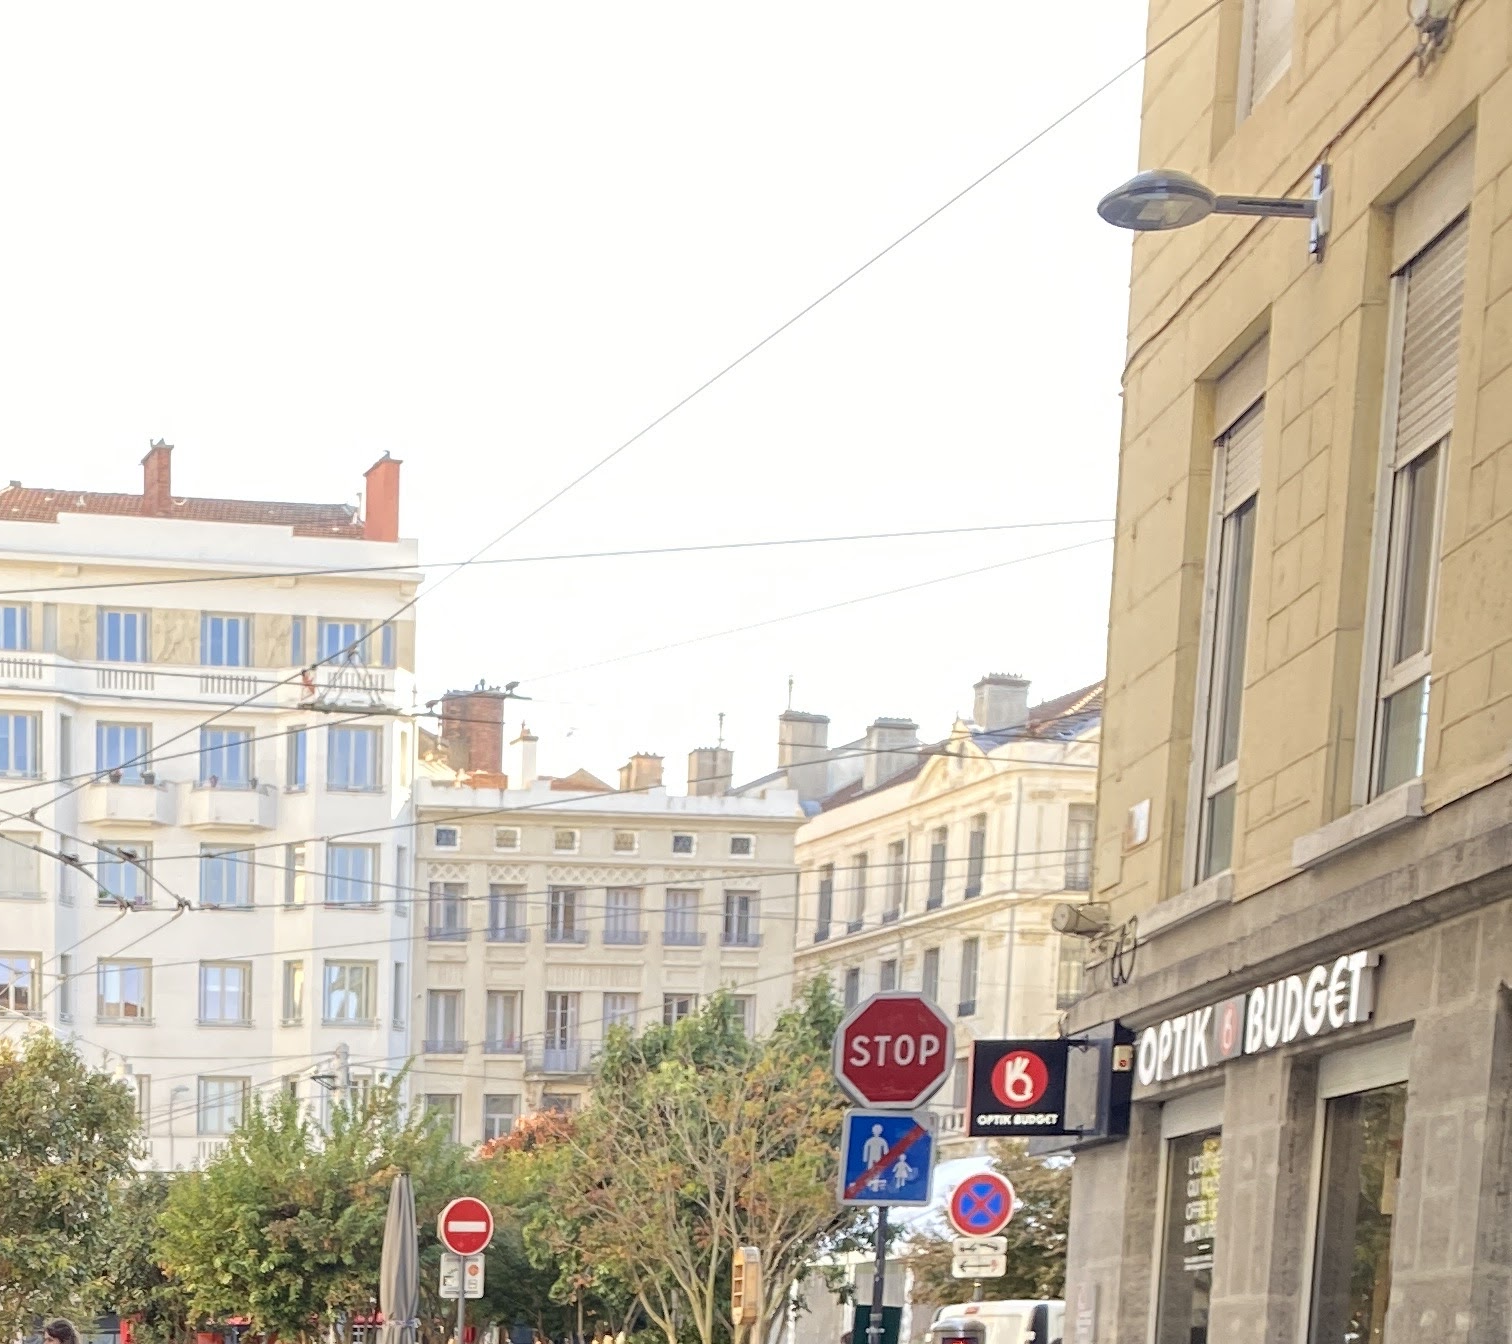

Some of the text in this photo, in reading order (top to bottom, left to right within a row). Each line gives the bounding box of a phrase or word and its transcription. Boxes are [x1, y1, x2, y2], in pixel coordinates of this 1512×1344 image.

[849, 1033, 941, 1067] STOP
[1137, 1005, 1213, 1087] OPTIK
[976, 1113, 1012, 1126] OPTIK
